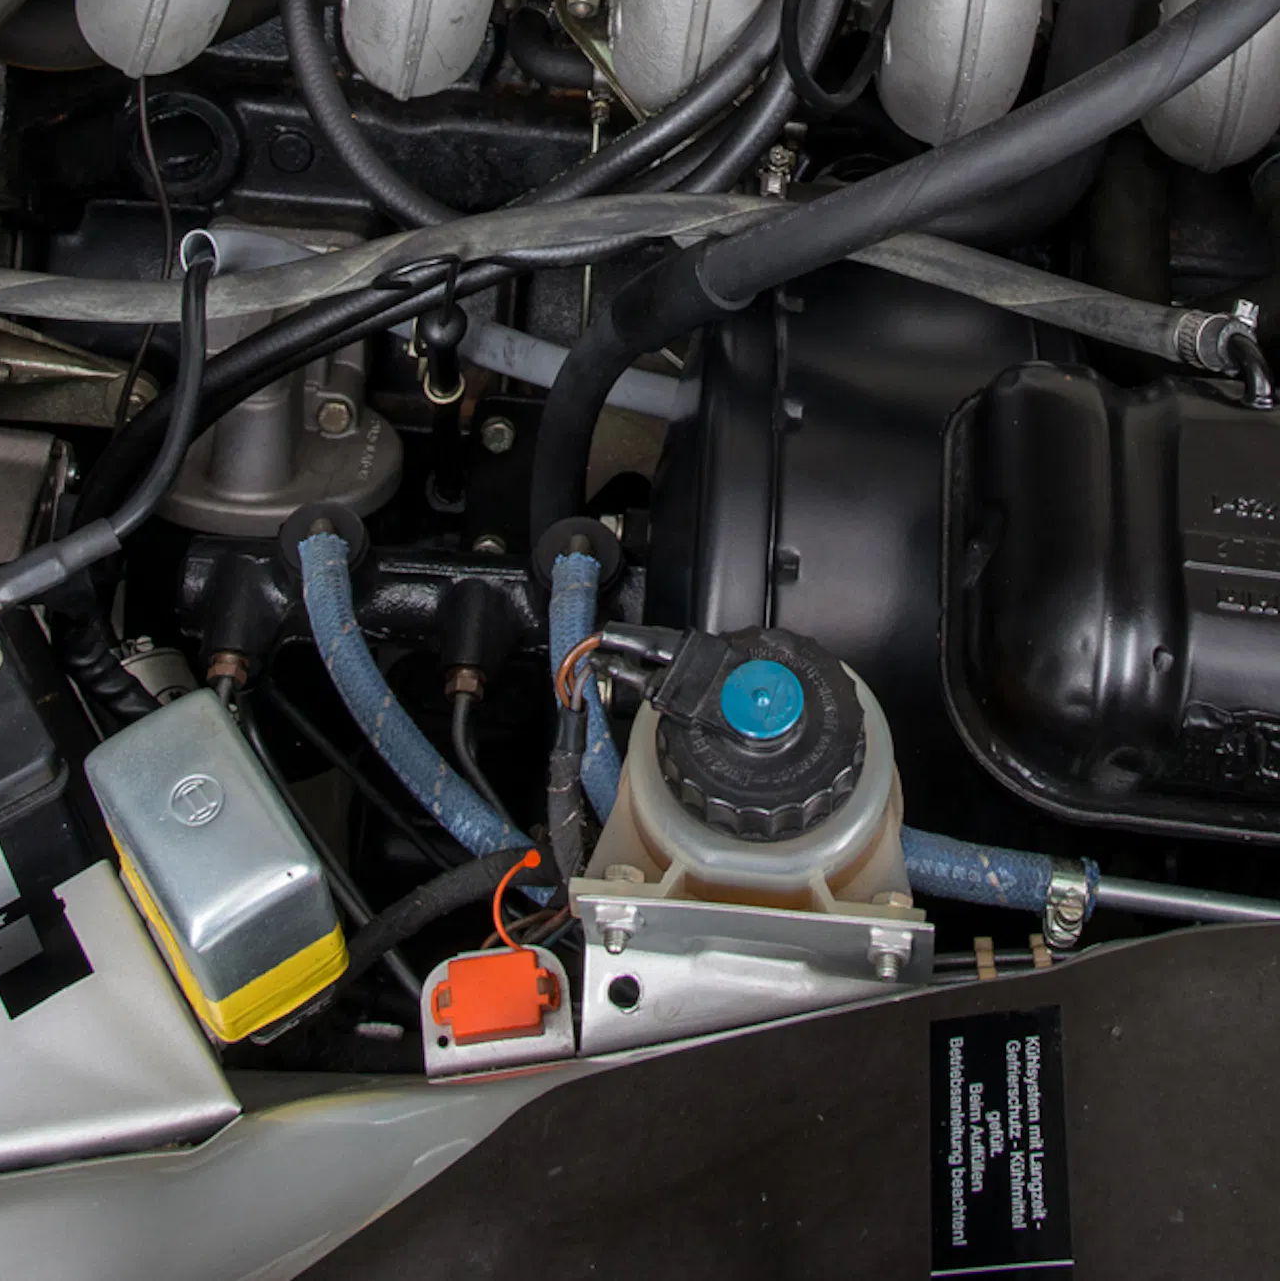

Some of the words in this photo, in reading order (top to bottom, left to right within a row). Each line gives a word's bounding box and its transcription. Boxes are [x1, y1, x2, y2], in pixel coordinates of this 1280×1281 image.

[948, 1036, 965, 1165] Betriebsanleitung
[969, 1082, 985, 1121] Beim
[1006, 1040, 1024, 1139] Gefrierschutz
[1024, 1035, 1044, 1122] Kühlsystem
[969, 1126, 986, 1192] Auffüllen
[1029, 1125, 1044, 1150] mit
[1009, 1151, 1027, 1229] Kühlmittel
[1027, 1153, 1046, 1219] Langzeit
